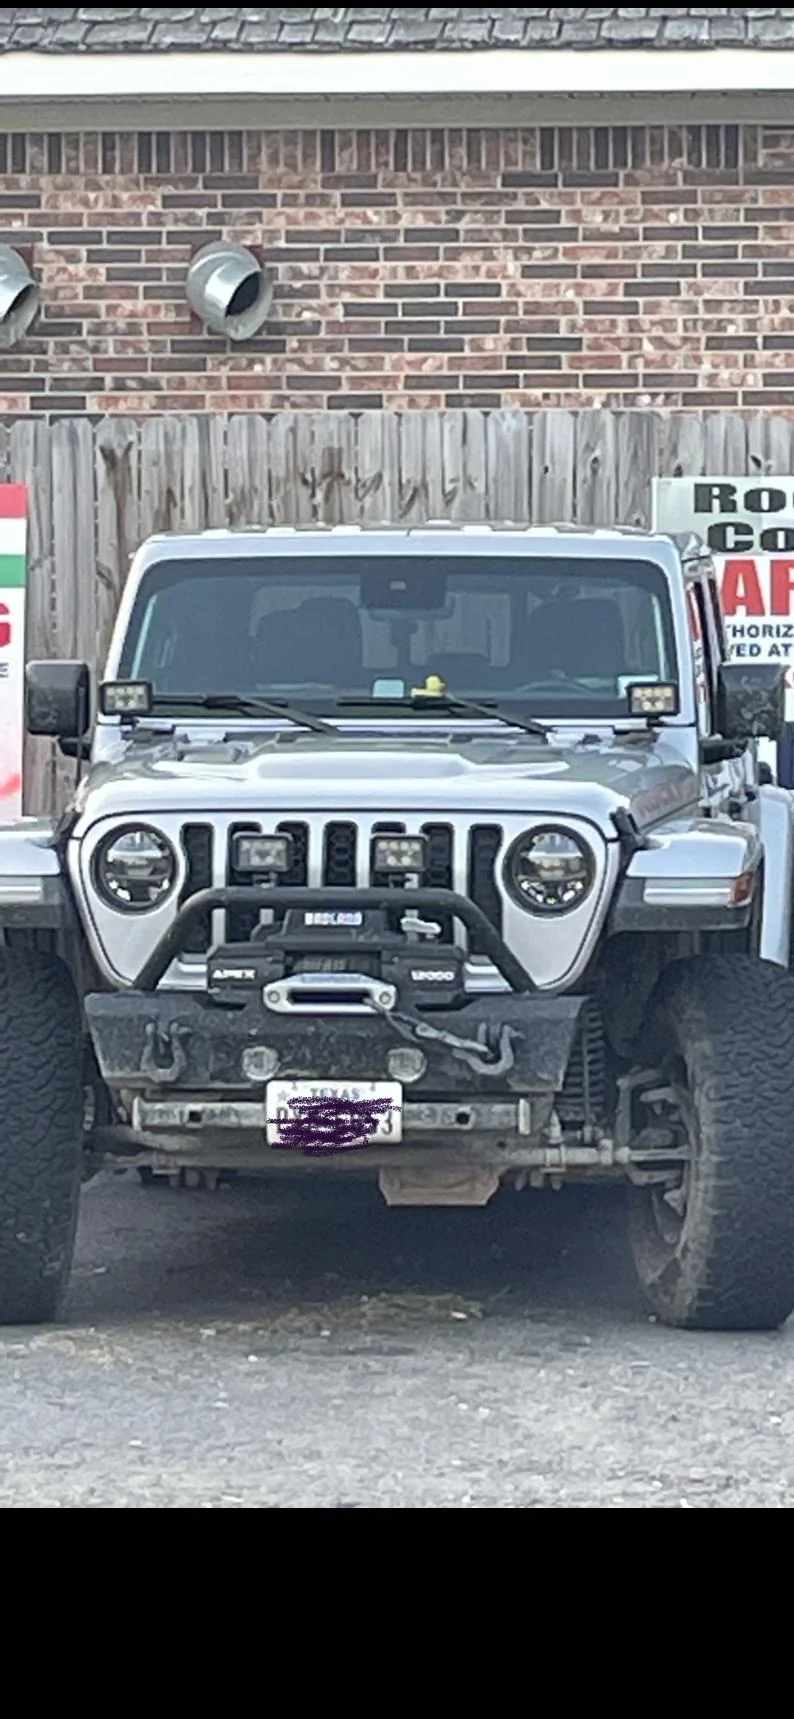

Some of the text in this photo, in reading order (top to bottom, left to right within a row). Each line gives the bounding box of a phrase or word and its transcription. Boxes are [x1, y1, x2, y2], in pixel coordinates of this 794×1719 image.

[694, 483, 794, 513] Ro
[726, 624, 794, 638] HORIZ
[212, 968, 256, 980] APEX
[310, 1087, 361, 1100] TEXAS
